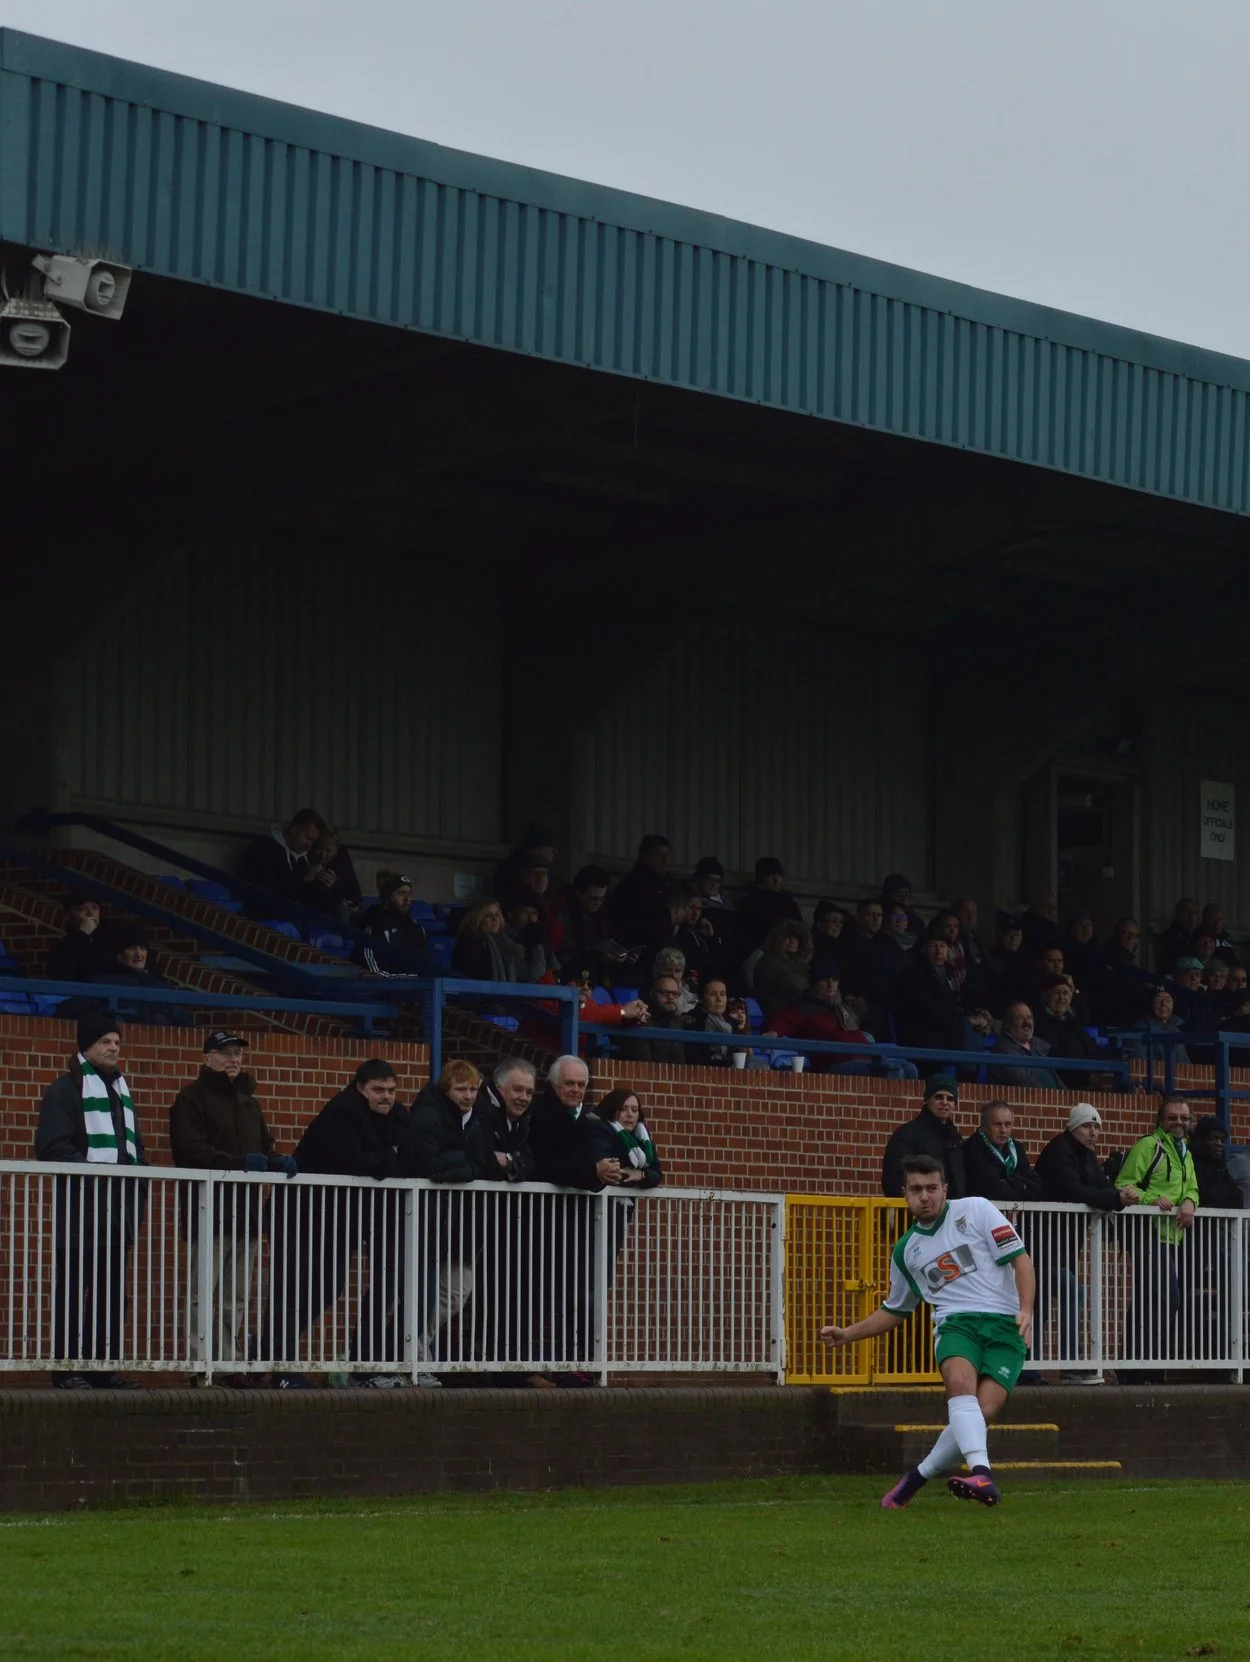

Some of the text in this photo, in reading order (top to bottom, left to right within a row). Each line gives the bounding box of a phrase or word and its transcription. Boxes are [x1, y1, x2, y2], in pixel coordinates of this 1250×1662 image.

[1206, 798, 1230, 813] HOME
[1210, 832, 1225, 843] ONLY
[923, 1250, 976, 1290] CSL
